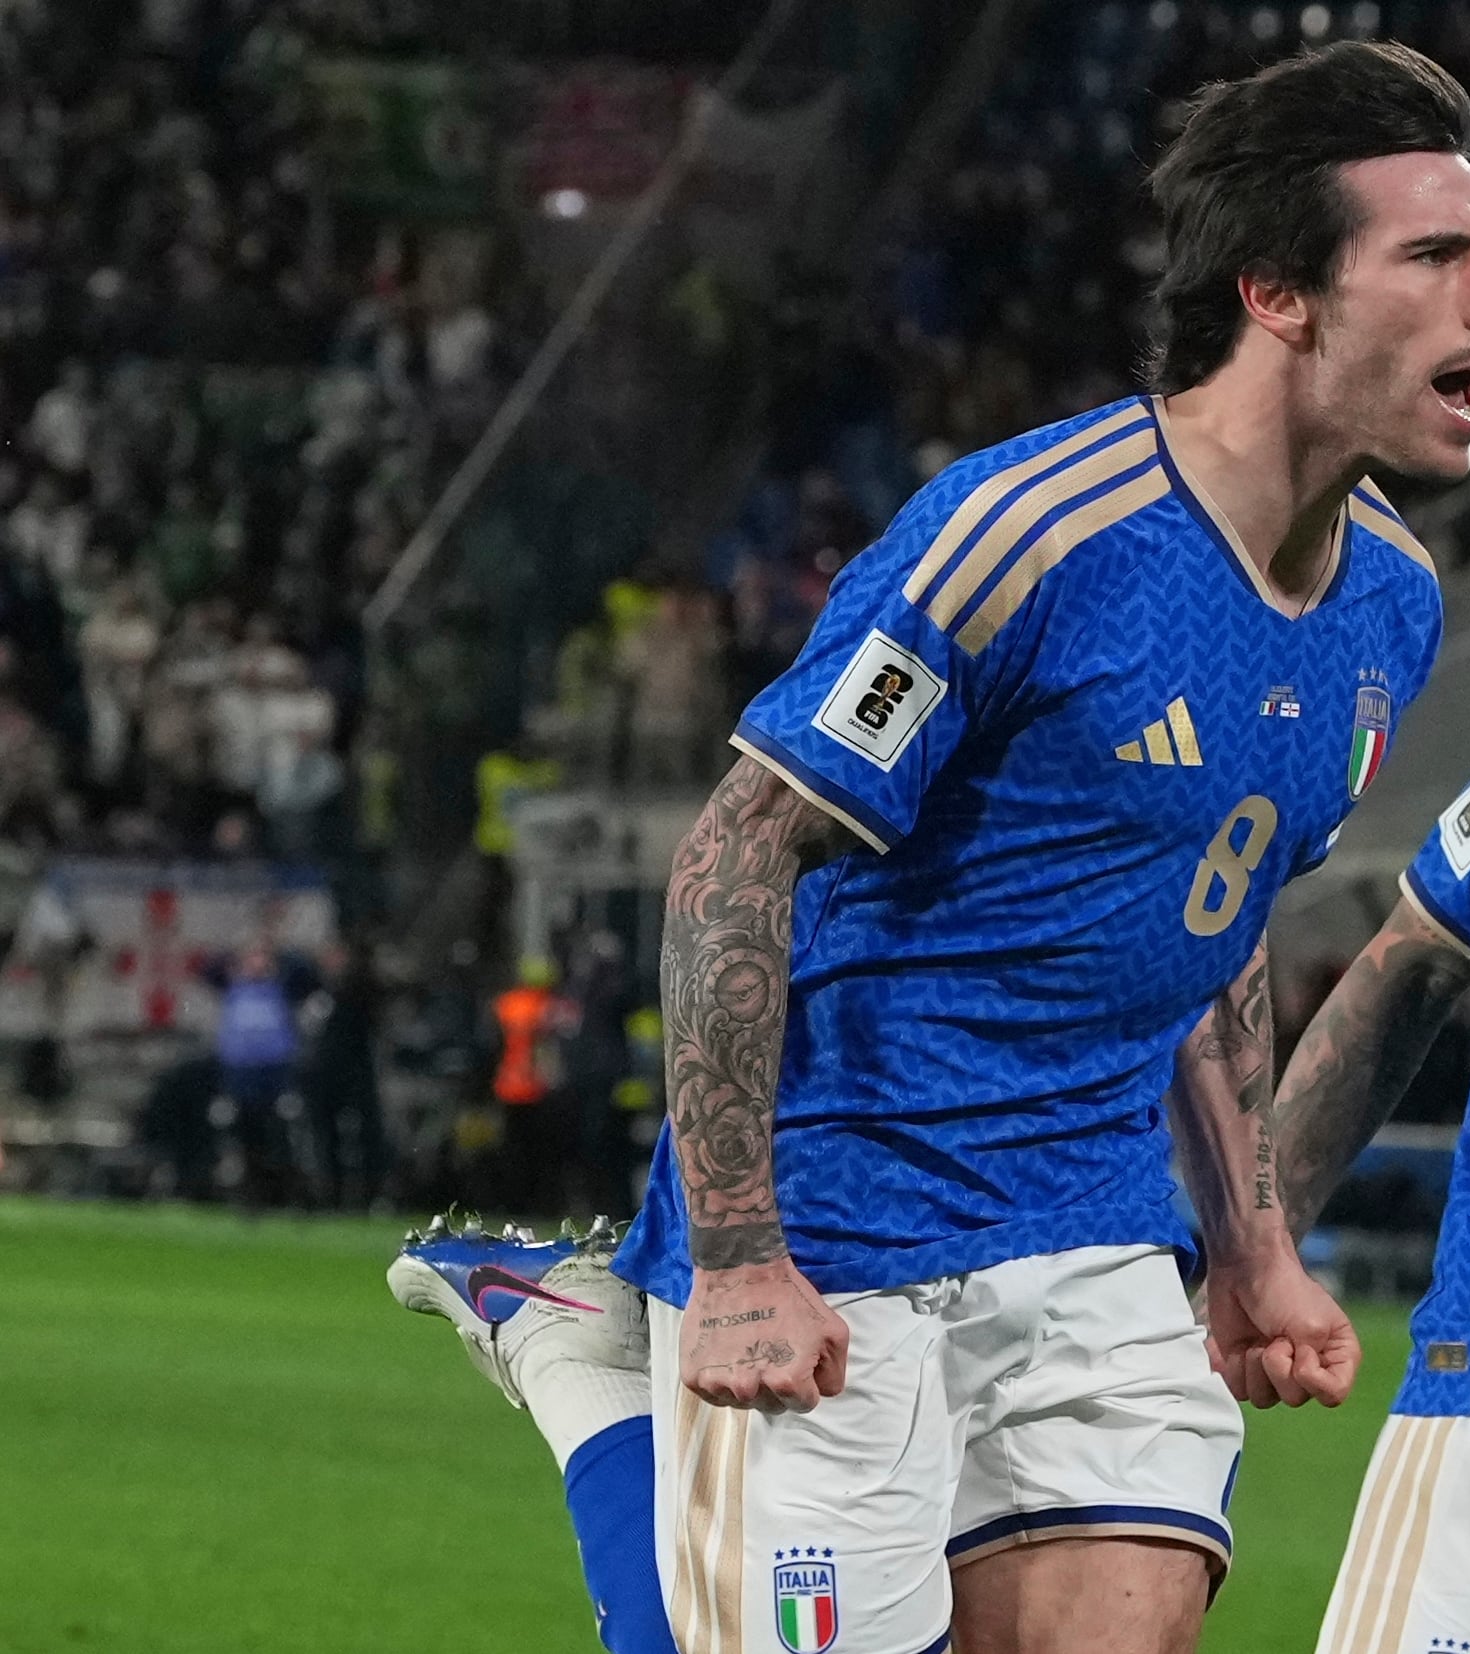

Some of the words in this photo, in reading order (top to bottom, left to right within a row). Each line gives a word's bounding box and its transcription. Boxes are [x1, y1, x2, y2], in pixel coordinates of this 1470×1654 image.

[1184, 794, 1278, 937] 8
[700, 1307, 777, 1330] IMPOSSIBLE
[779, 1570, 830, 1588] ITALIA
